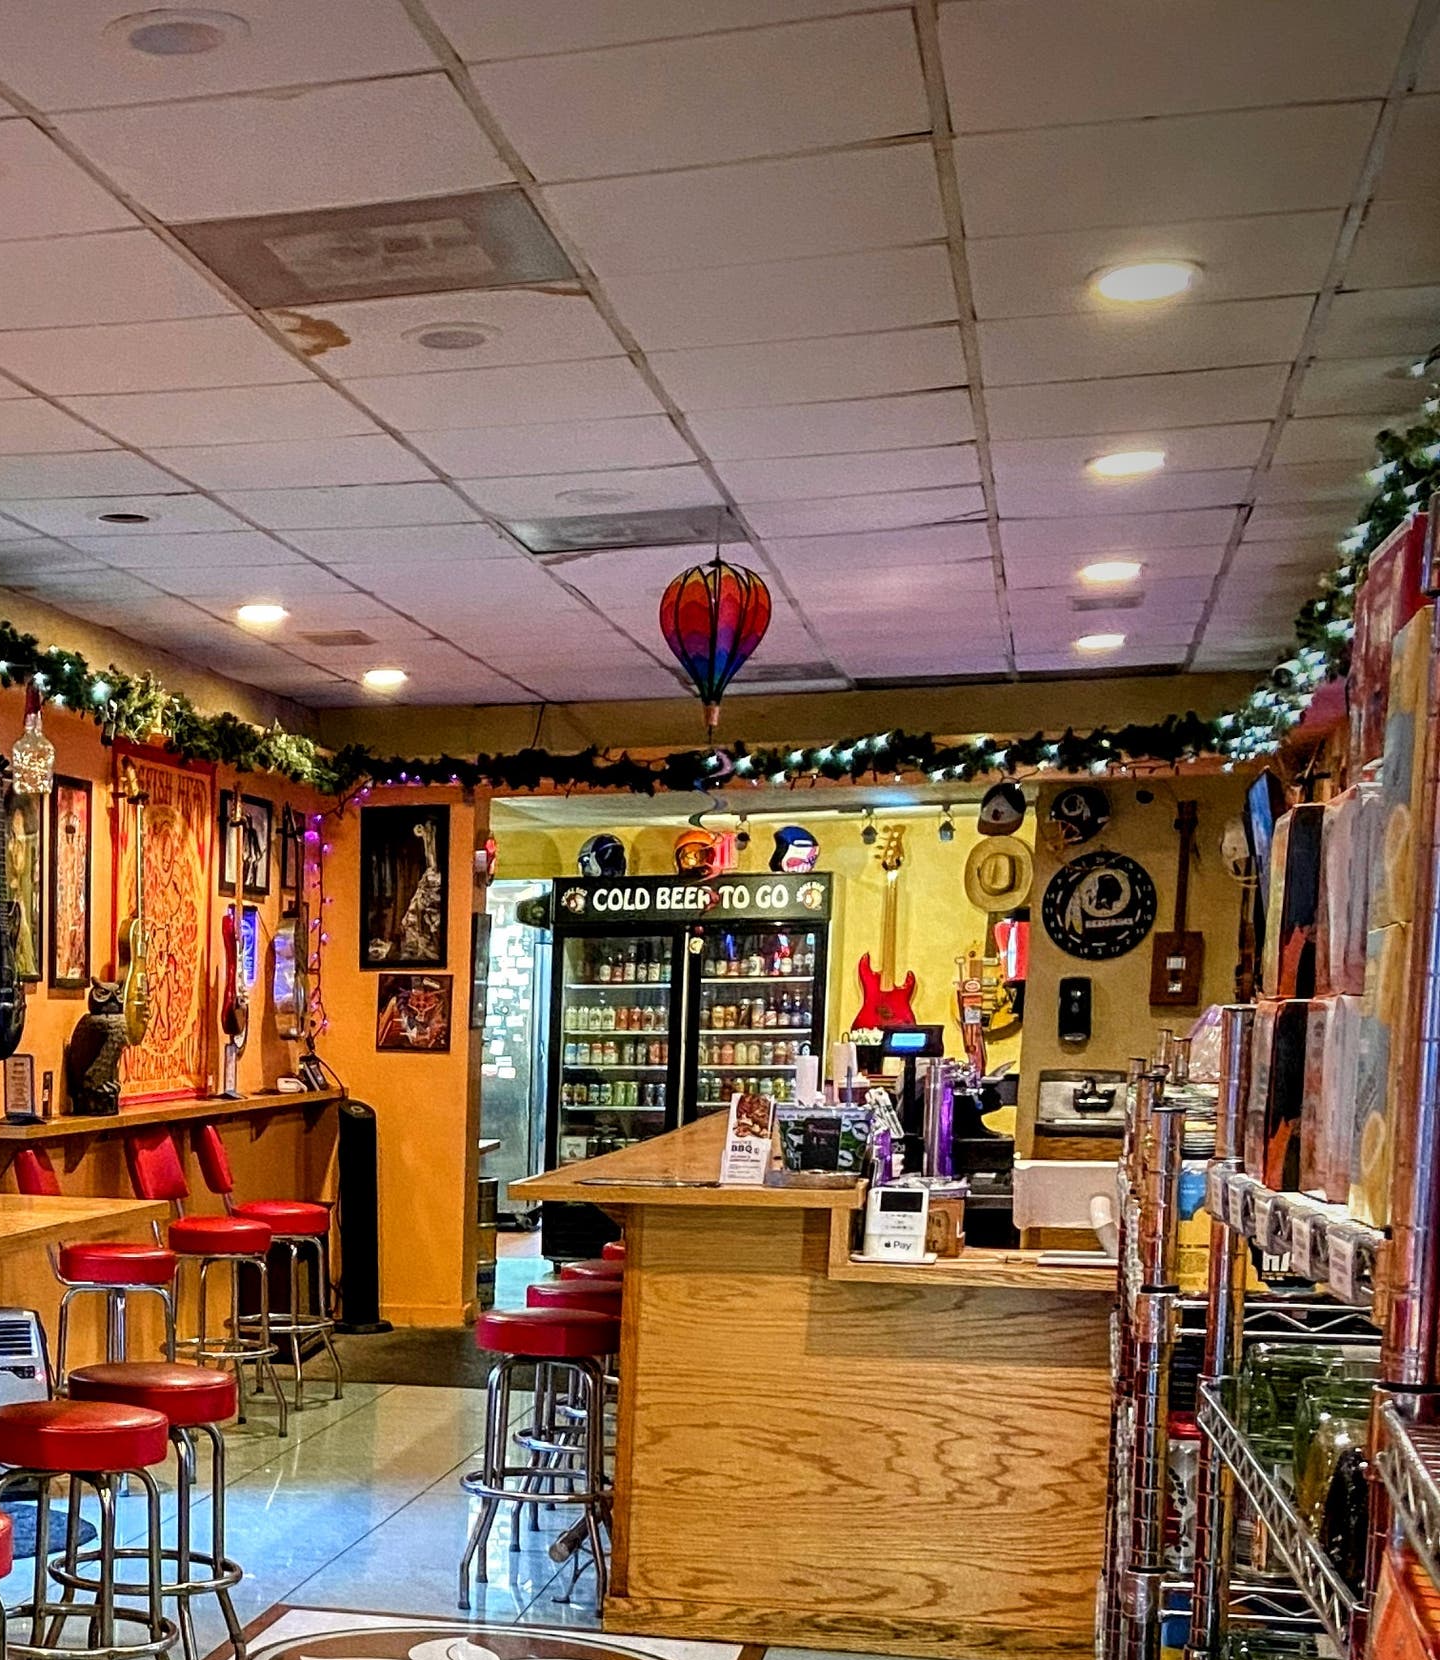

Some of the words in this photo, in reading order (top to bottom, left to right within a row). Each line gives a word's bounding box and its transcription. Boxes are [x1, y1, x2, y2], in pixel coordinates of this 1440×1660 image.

[592, 887, 651, 912] COLD
[718, 885, 750, 910] TO
[755, 884, 789, 909] GO
[731, 1144, 753, 1154] BBQ
[893, 1240, 912, 1251] Pay
